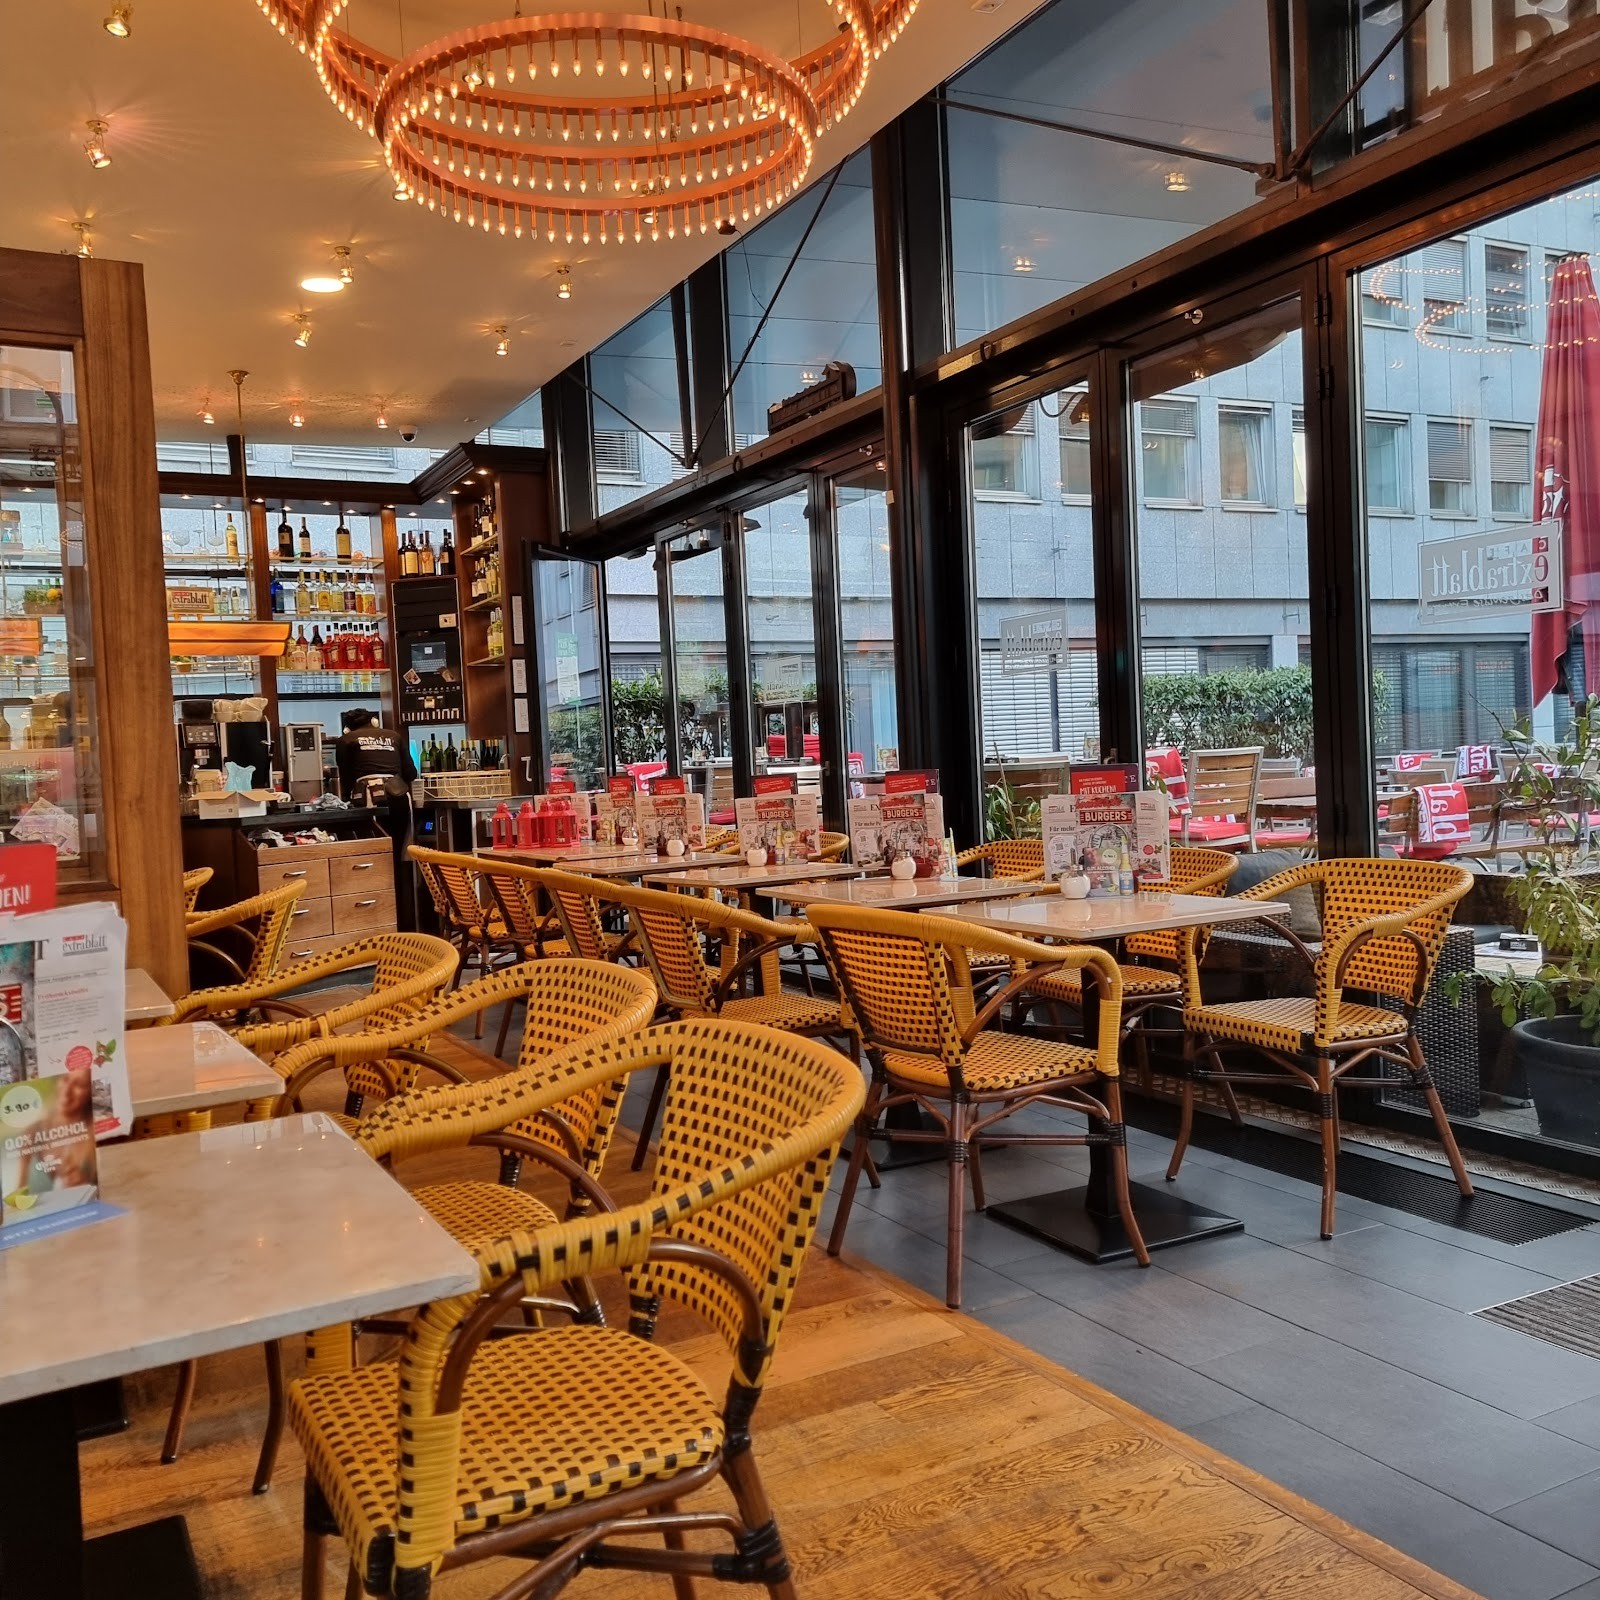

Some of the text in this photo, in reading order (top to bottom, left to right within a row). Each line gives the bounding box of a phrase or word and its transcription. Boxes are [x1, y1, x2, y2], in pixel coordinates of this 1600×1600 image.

[172, 592, 209, 604] extrablatt
[886, 808, 919, 818] BURGERS
[1084, 810, 1128, 822] BURGERS
[0, 884, 31, 909] EN!
[62, 933, 108, 953] extrablatt
[34, 1121, 88, 1144] ALCOHOL
